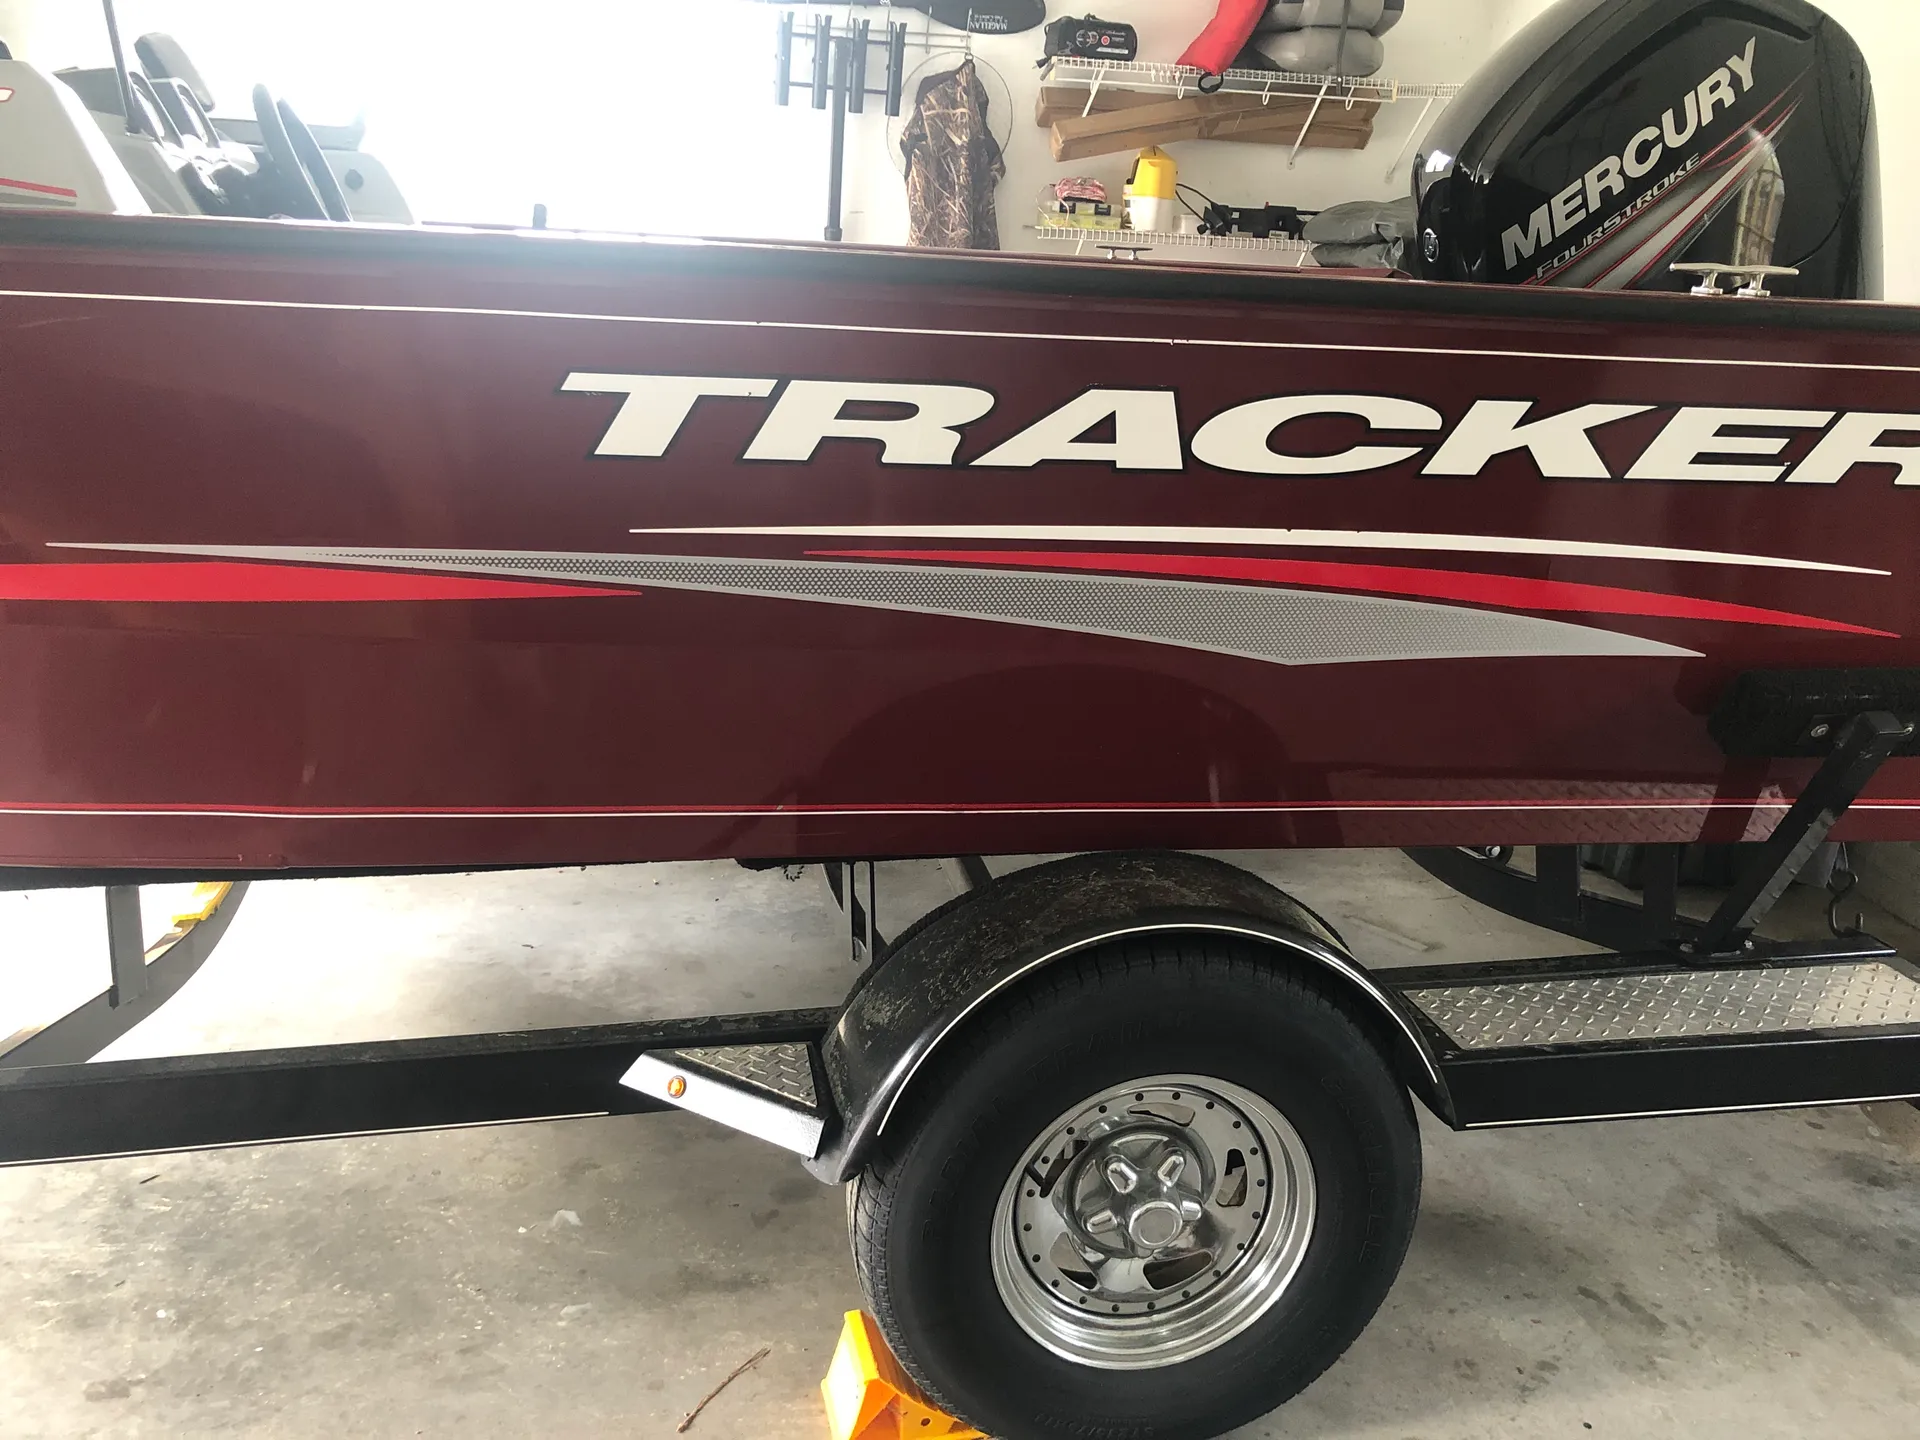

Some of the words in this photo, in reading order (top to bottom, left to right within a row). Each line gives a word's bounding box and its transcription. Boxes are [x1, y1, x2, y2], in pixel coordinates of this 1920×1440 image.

[1500, 36, 1757, 271] MERCURY
[1536, 153, 1701, 280] FOURSTROKE
[559, 371, 1920, 486] TRACKER
